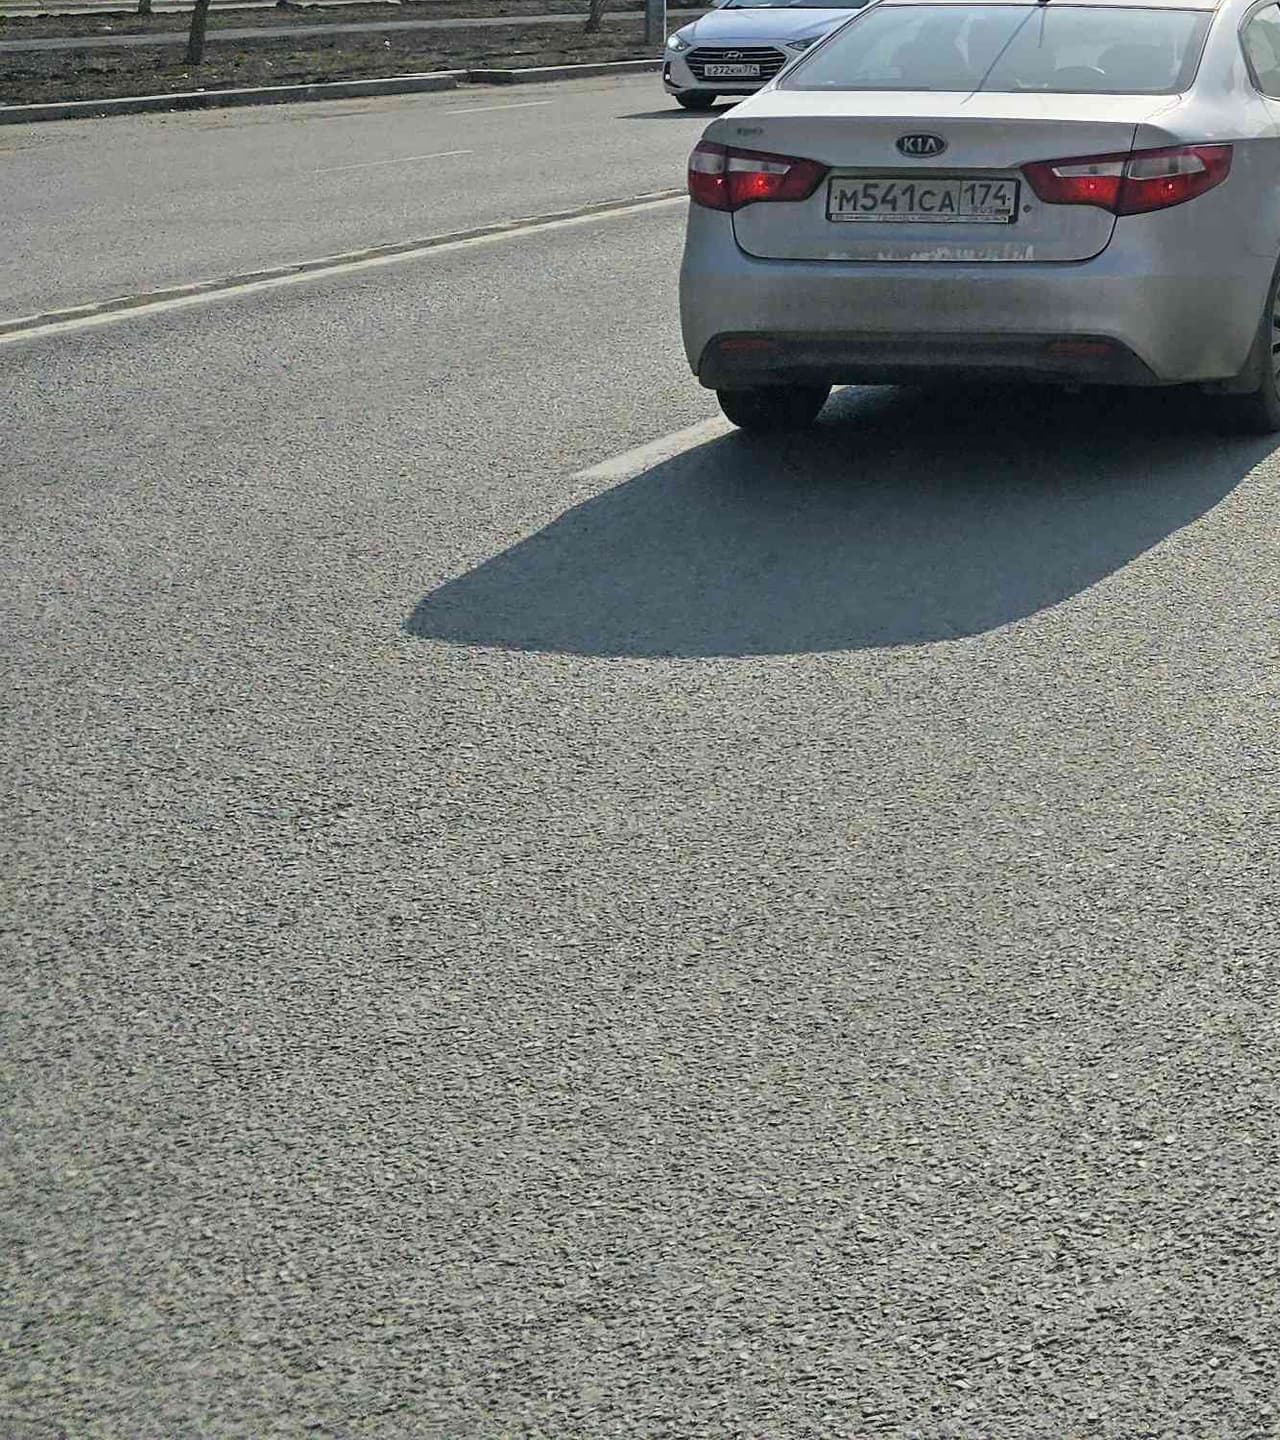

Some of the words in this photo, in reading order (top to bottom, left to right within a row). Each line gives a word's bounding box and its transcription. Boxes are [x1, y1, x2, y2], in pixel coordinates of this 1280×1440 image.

[903, 139, 937, 153] KIA
[838, 184, 955, 211] М541СА
[964, 184, 1007, 206] 174
